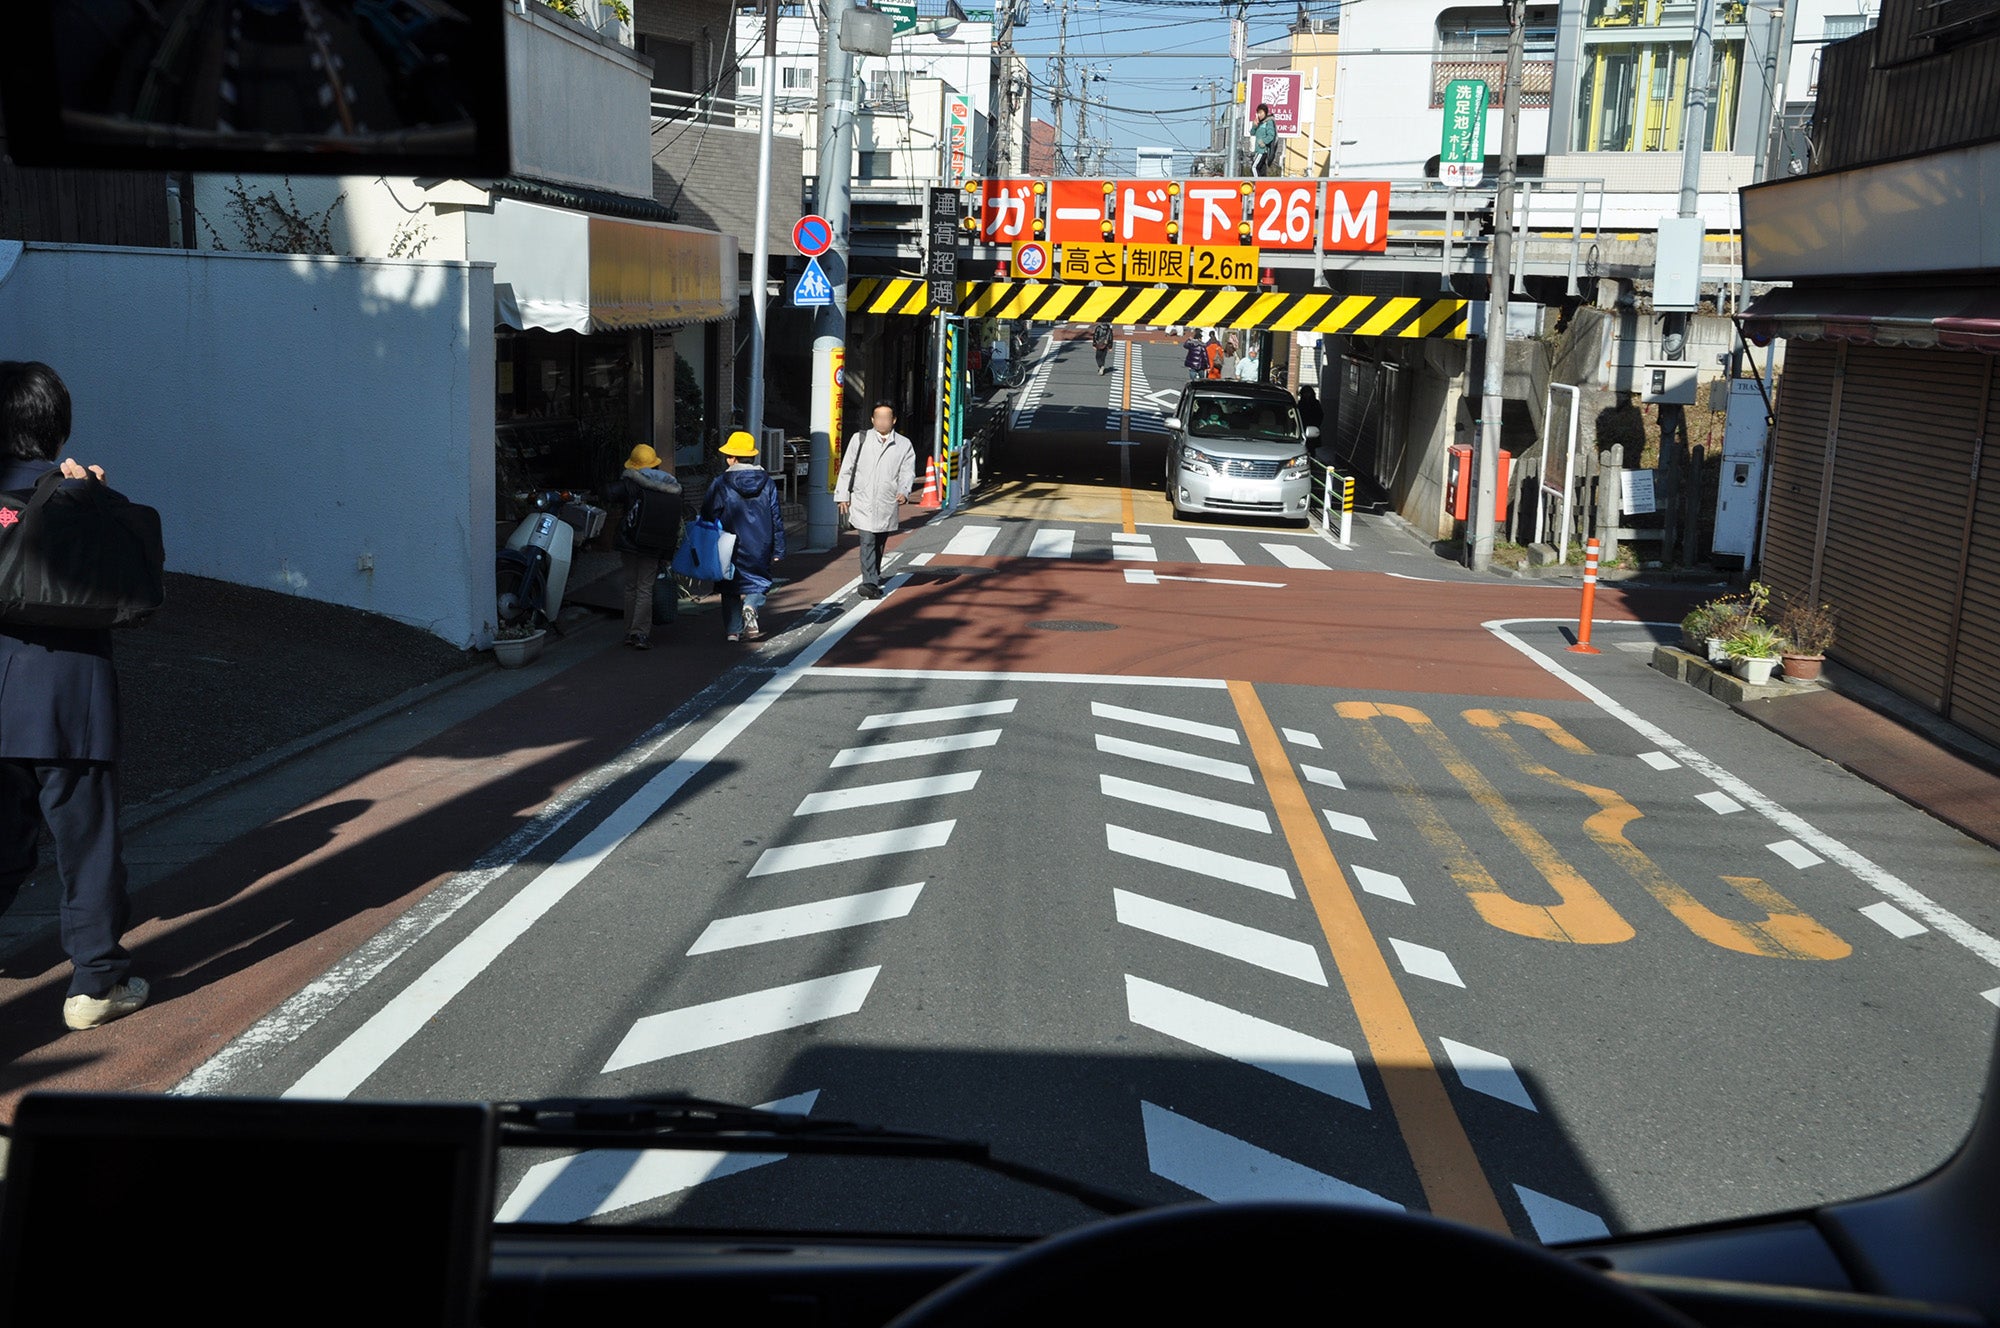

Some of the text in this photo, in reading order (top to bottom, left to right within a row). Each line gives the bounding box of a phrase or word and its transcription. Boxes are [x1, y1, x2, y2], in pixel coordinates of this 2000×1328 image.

[891, 15, 911, 23] corp.
[1453, 85, 1471, 130] 洗足池
[1448, 134, 1460, 160] ホール
[1737, 383, 1761, 391] TRAS
